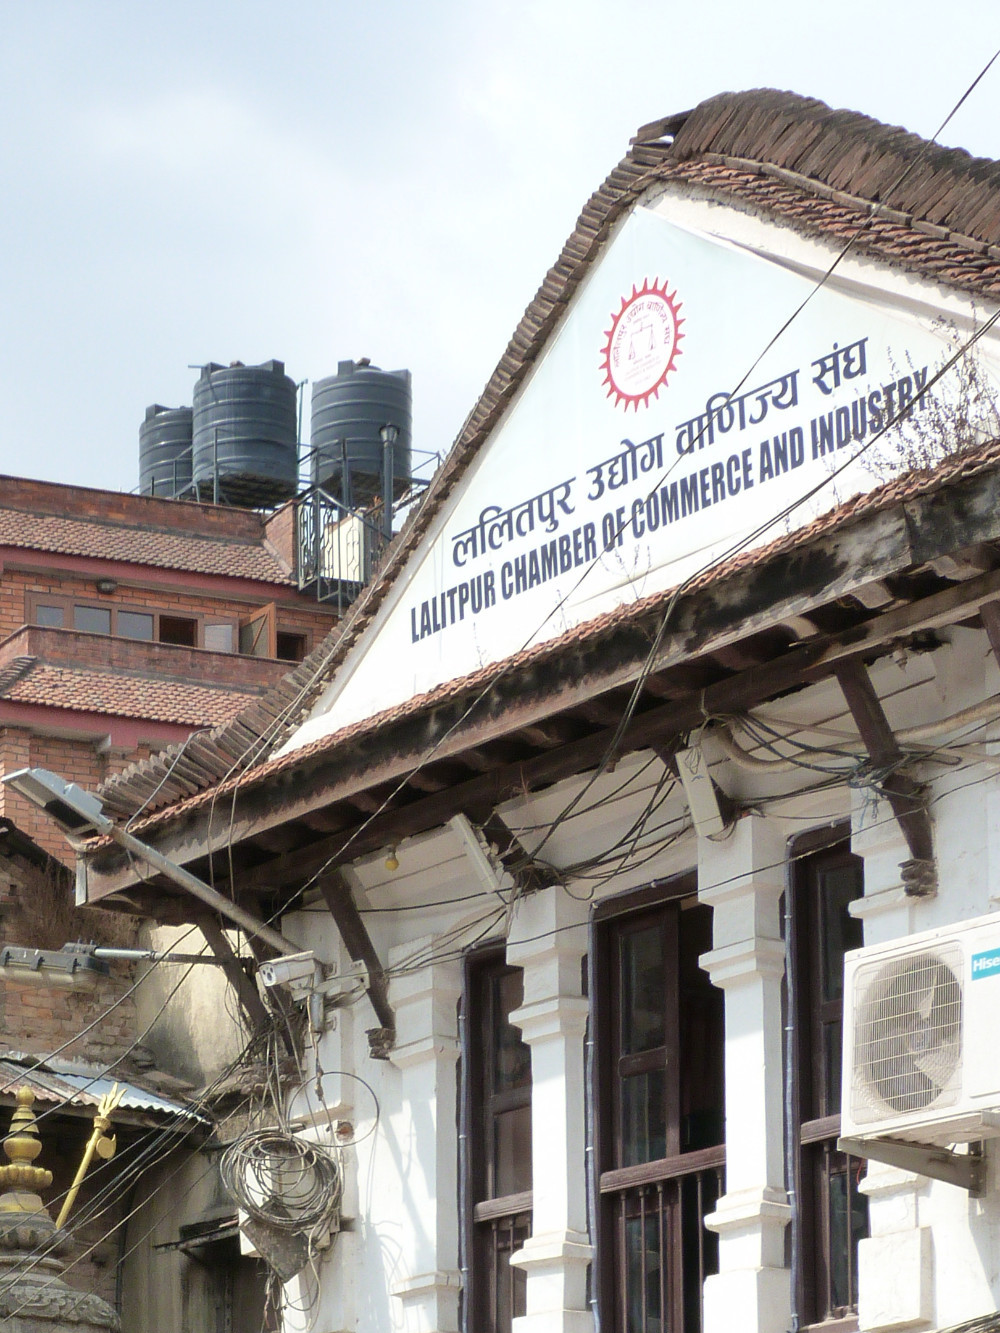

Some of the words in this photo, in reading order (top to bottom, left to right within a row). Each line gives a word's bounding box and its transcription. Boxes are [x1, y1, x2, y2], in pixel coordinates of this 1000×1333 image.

[410, 561, 497, 643] LALITPUR
[500, 521, 597, 601] CHAMBER
[602, 508, 627, 550] OF
[632, 446, 756, 535] COMMERCE
[759, 427, 806, 482] AND
[811, 366, 930, 454] INDUSTRY
[451, 477, 576, 568] ललितपुर
[587, 433, 664, 502] उद्योग
[675, 368, 800, 456] वाणिज्य
[812, 337, 869, 396] संघ
